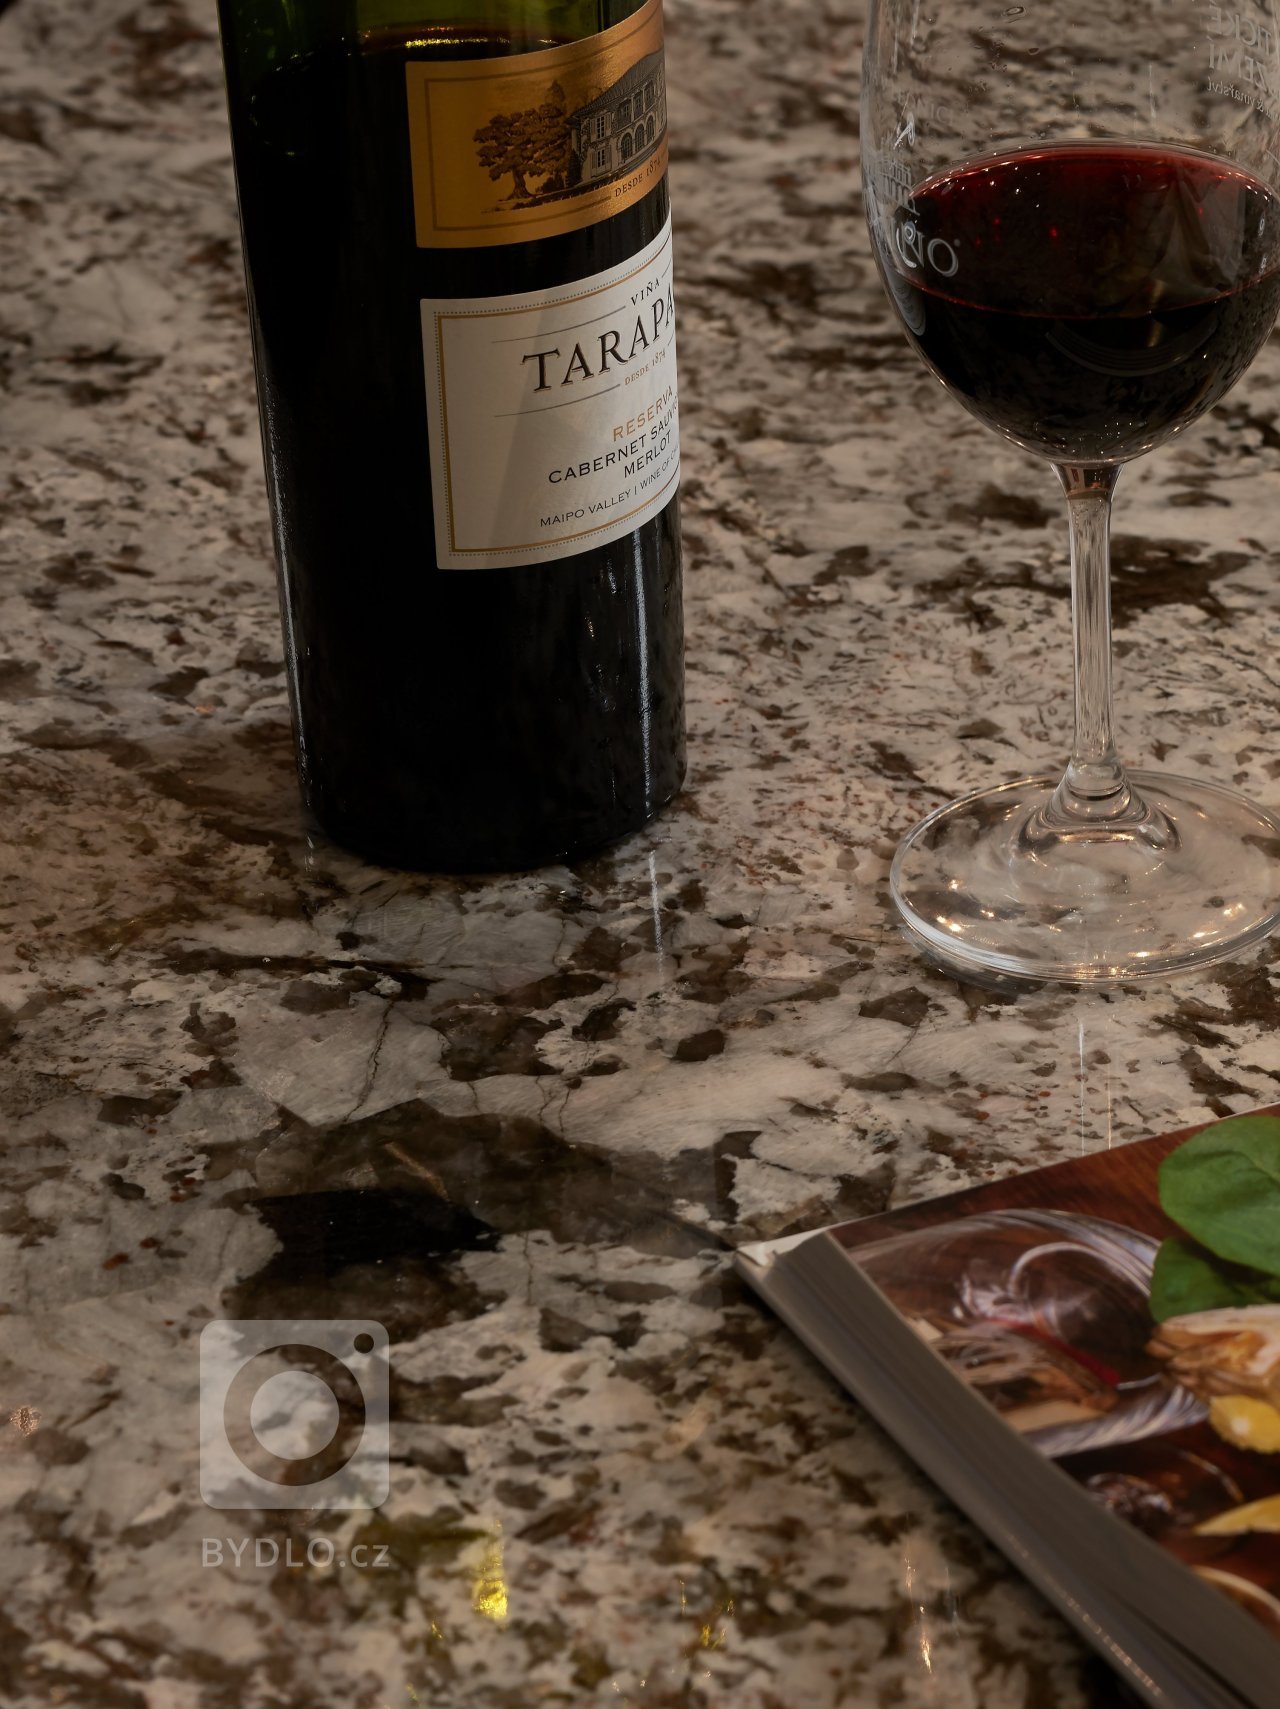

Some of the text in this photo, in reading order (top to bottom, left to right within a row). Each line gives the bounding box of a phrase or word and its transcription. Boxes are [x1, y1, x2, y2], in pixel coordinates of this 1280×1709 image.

[615, 173, 643, 197] DESDE
[630, 277, 660, 306] VIÑA
[624, 350, 667, 386] DESDE 1874
[612, 385, 673, 442] RESERVA
[548, 433, 647, 484] CABERNET
[623, 429, 672, 479] MERLOT
[540, 508, 585, 527] MAIPO
[588, 488, 631, 514] VALLEY
[639, 468, 661, 490] WINE
